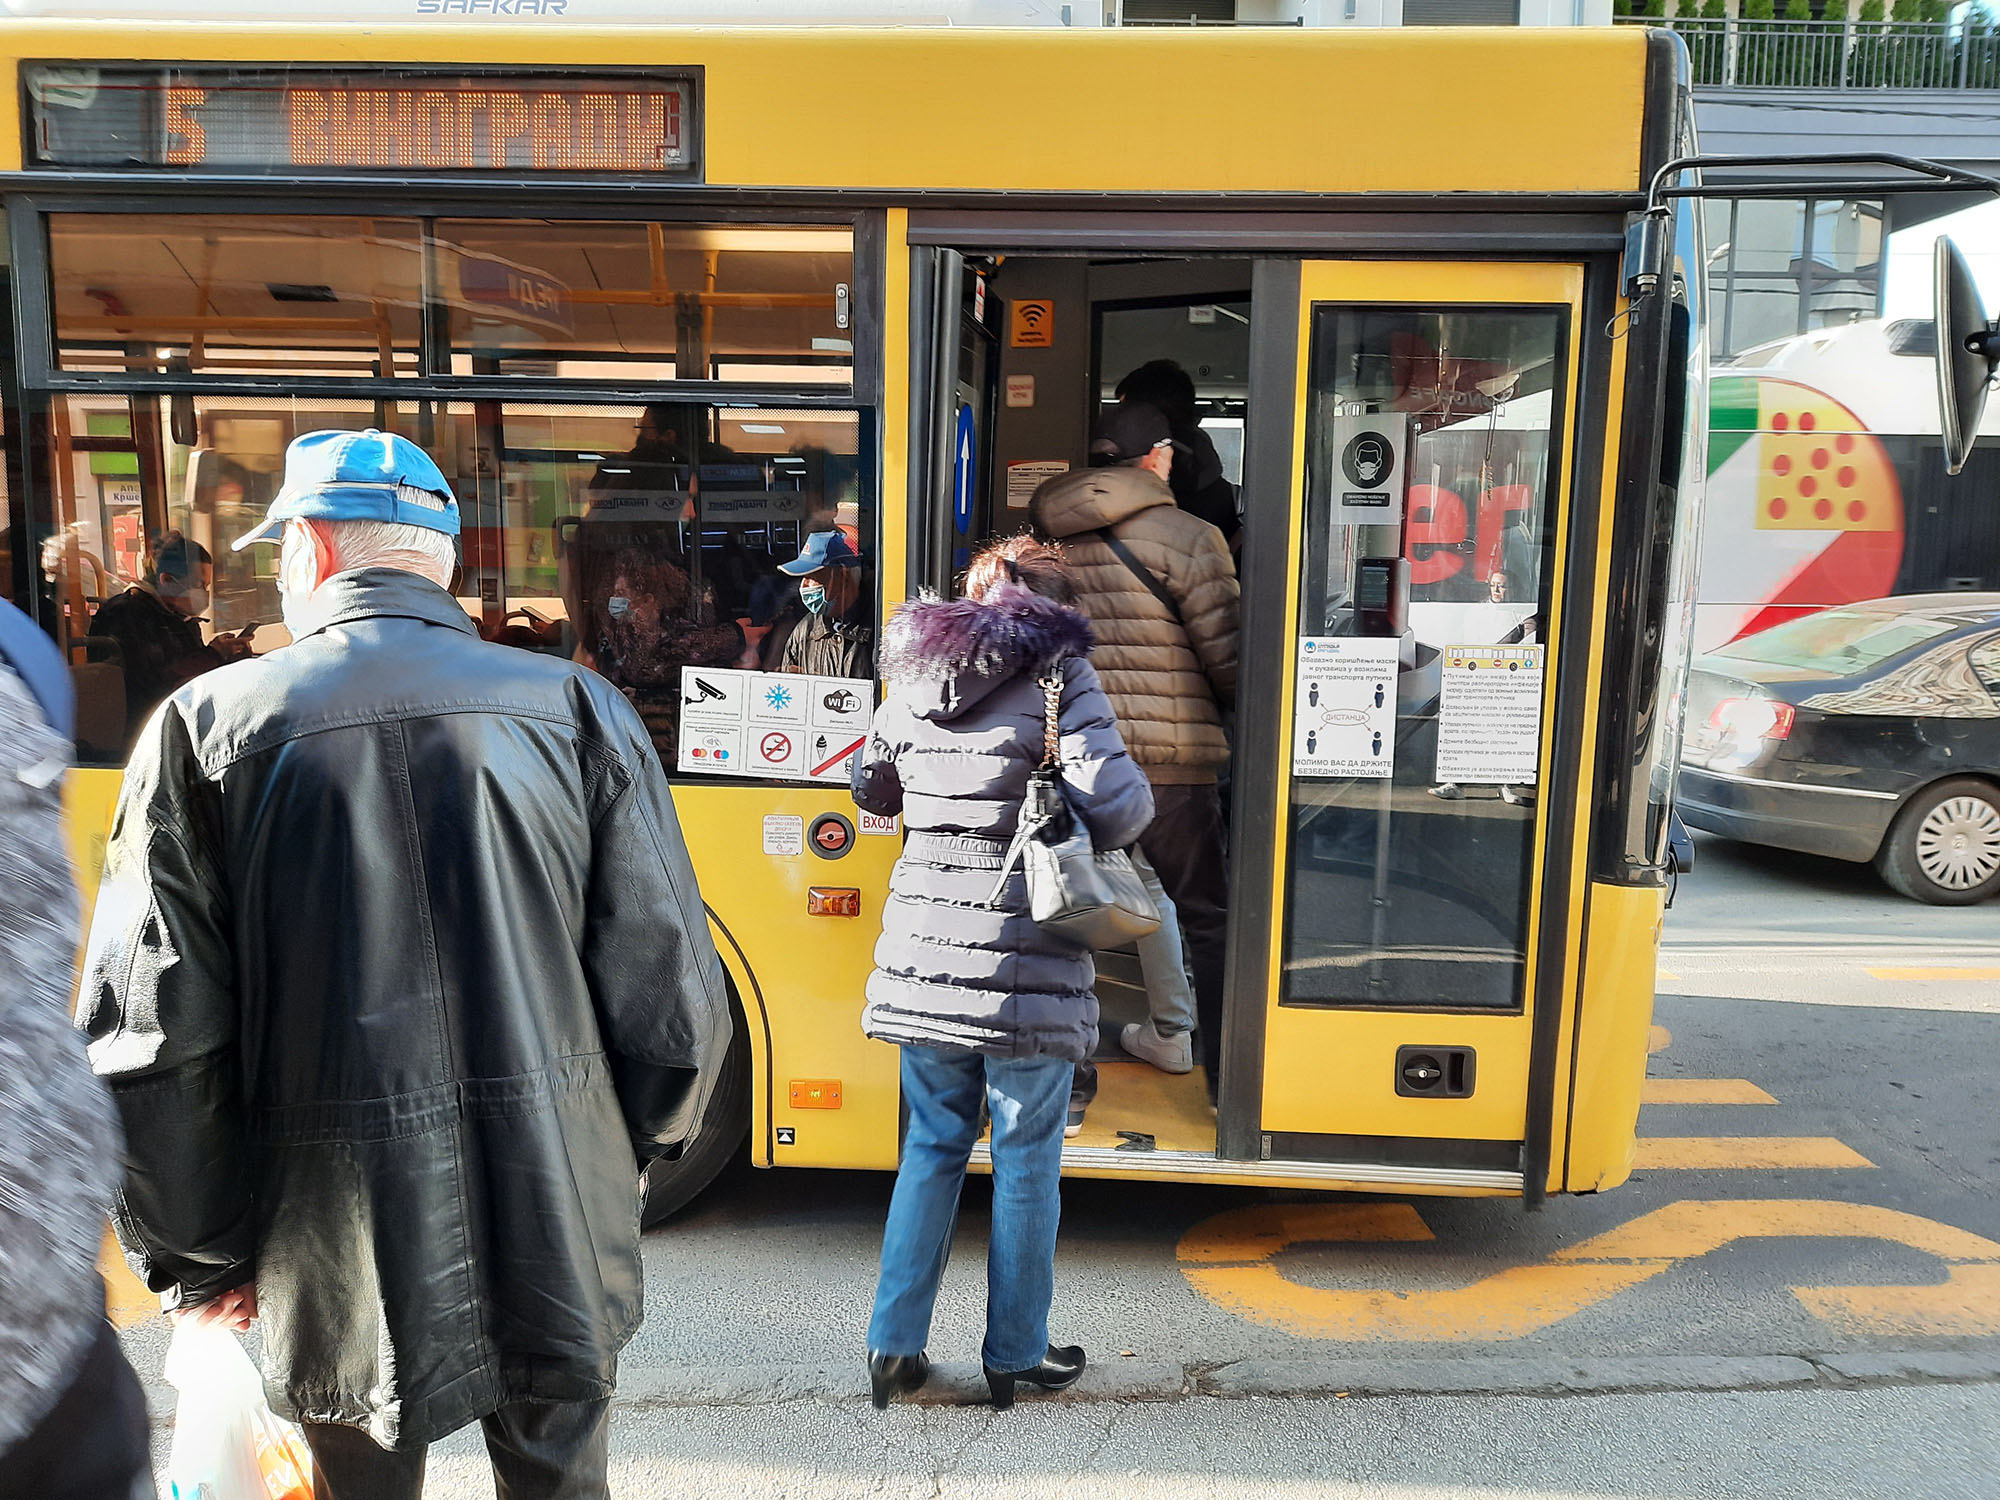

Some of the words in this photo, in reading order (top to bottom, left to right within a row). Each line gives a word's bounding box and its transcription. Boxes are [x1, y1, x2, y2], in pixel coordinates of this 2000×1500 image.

[417, 0, 568, 15] SAFKAR
[167, 89, 207, 165] 5
[290, 89, 665, 171] ВИНОГРАДИ
[1326, 713, 1366, 722] ДИСТАНЦА
[1360, 760, 1392, 768] ДРЖИТЕ
[1341, 768, 1389, 776] РАСТОЈАЊЕ
[863, 816, 894, 831] ВХОД
